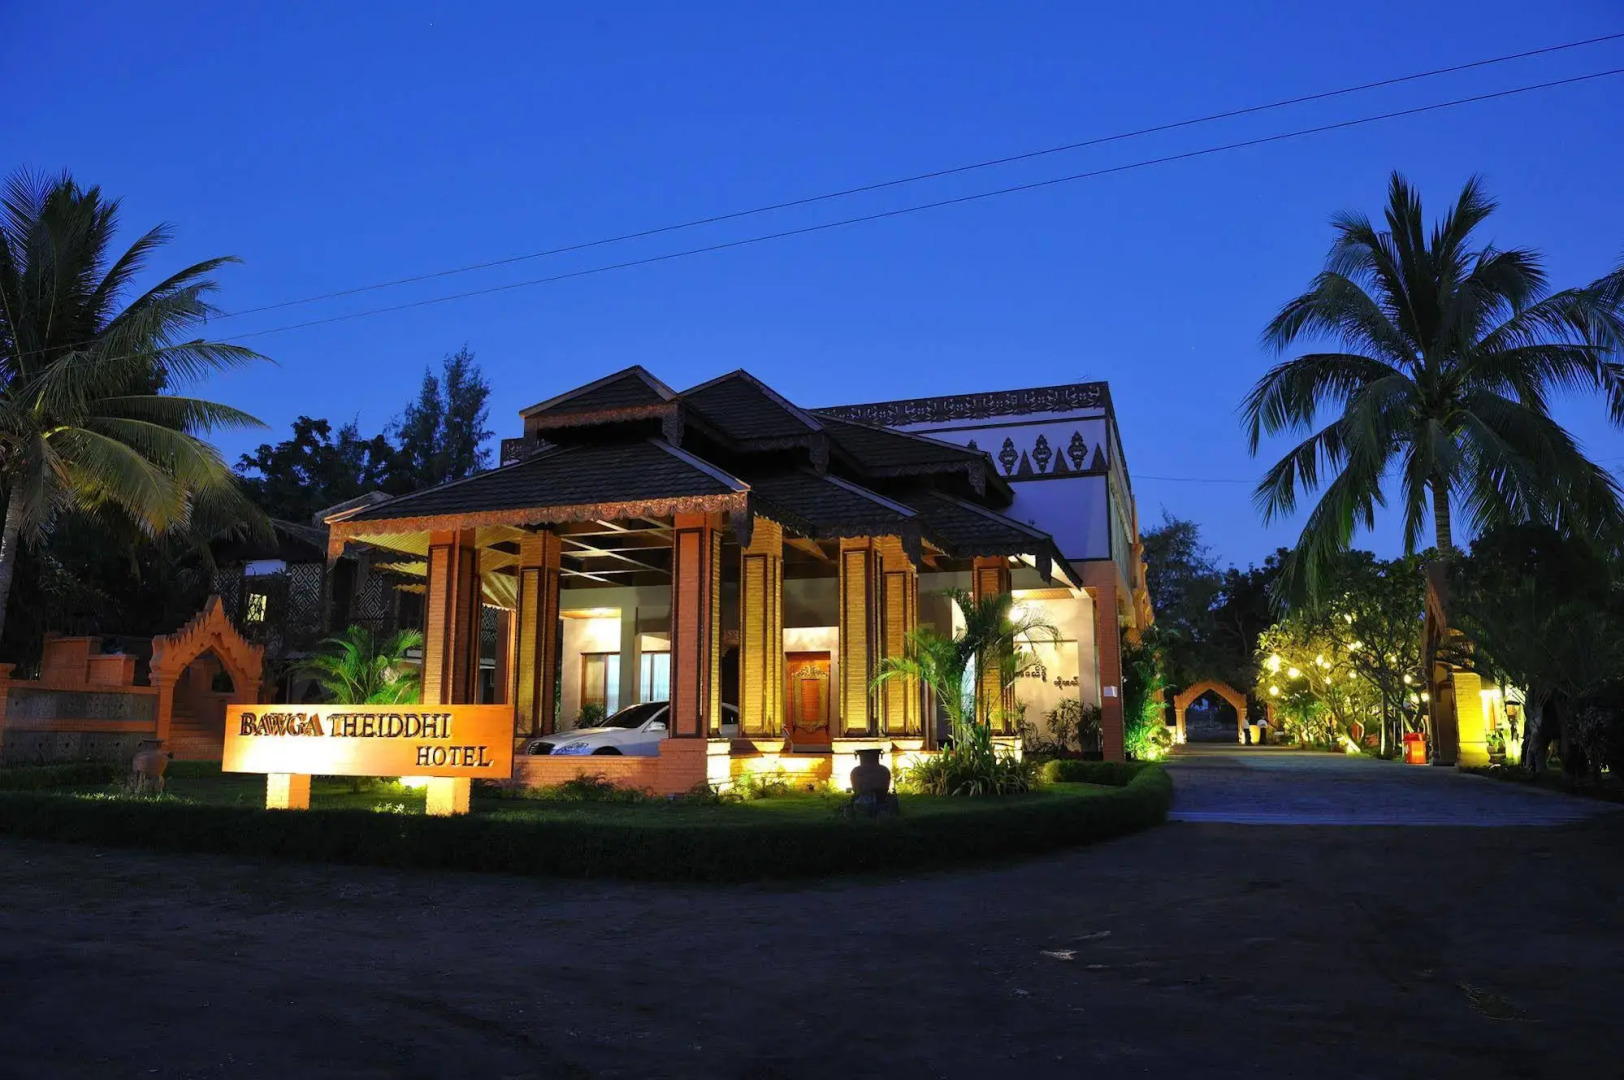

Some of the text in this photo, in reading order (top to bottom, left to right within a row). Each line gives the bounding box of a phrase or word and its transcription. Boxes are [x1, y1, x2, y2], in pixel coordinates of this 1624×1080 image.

[239, 712, 451, 738] BAWGA THEIDDHI
[416, 746, 493, 767] HOTEL
